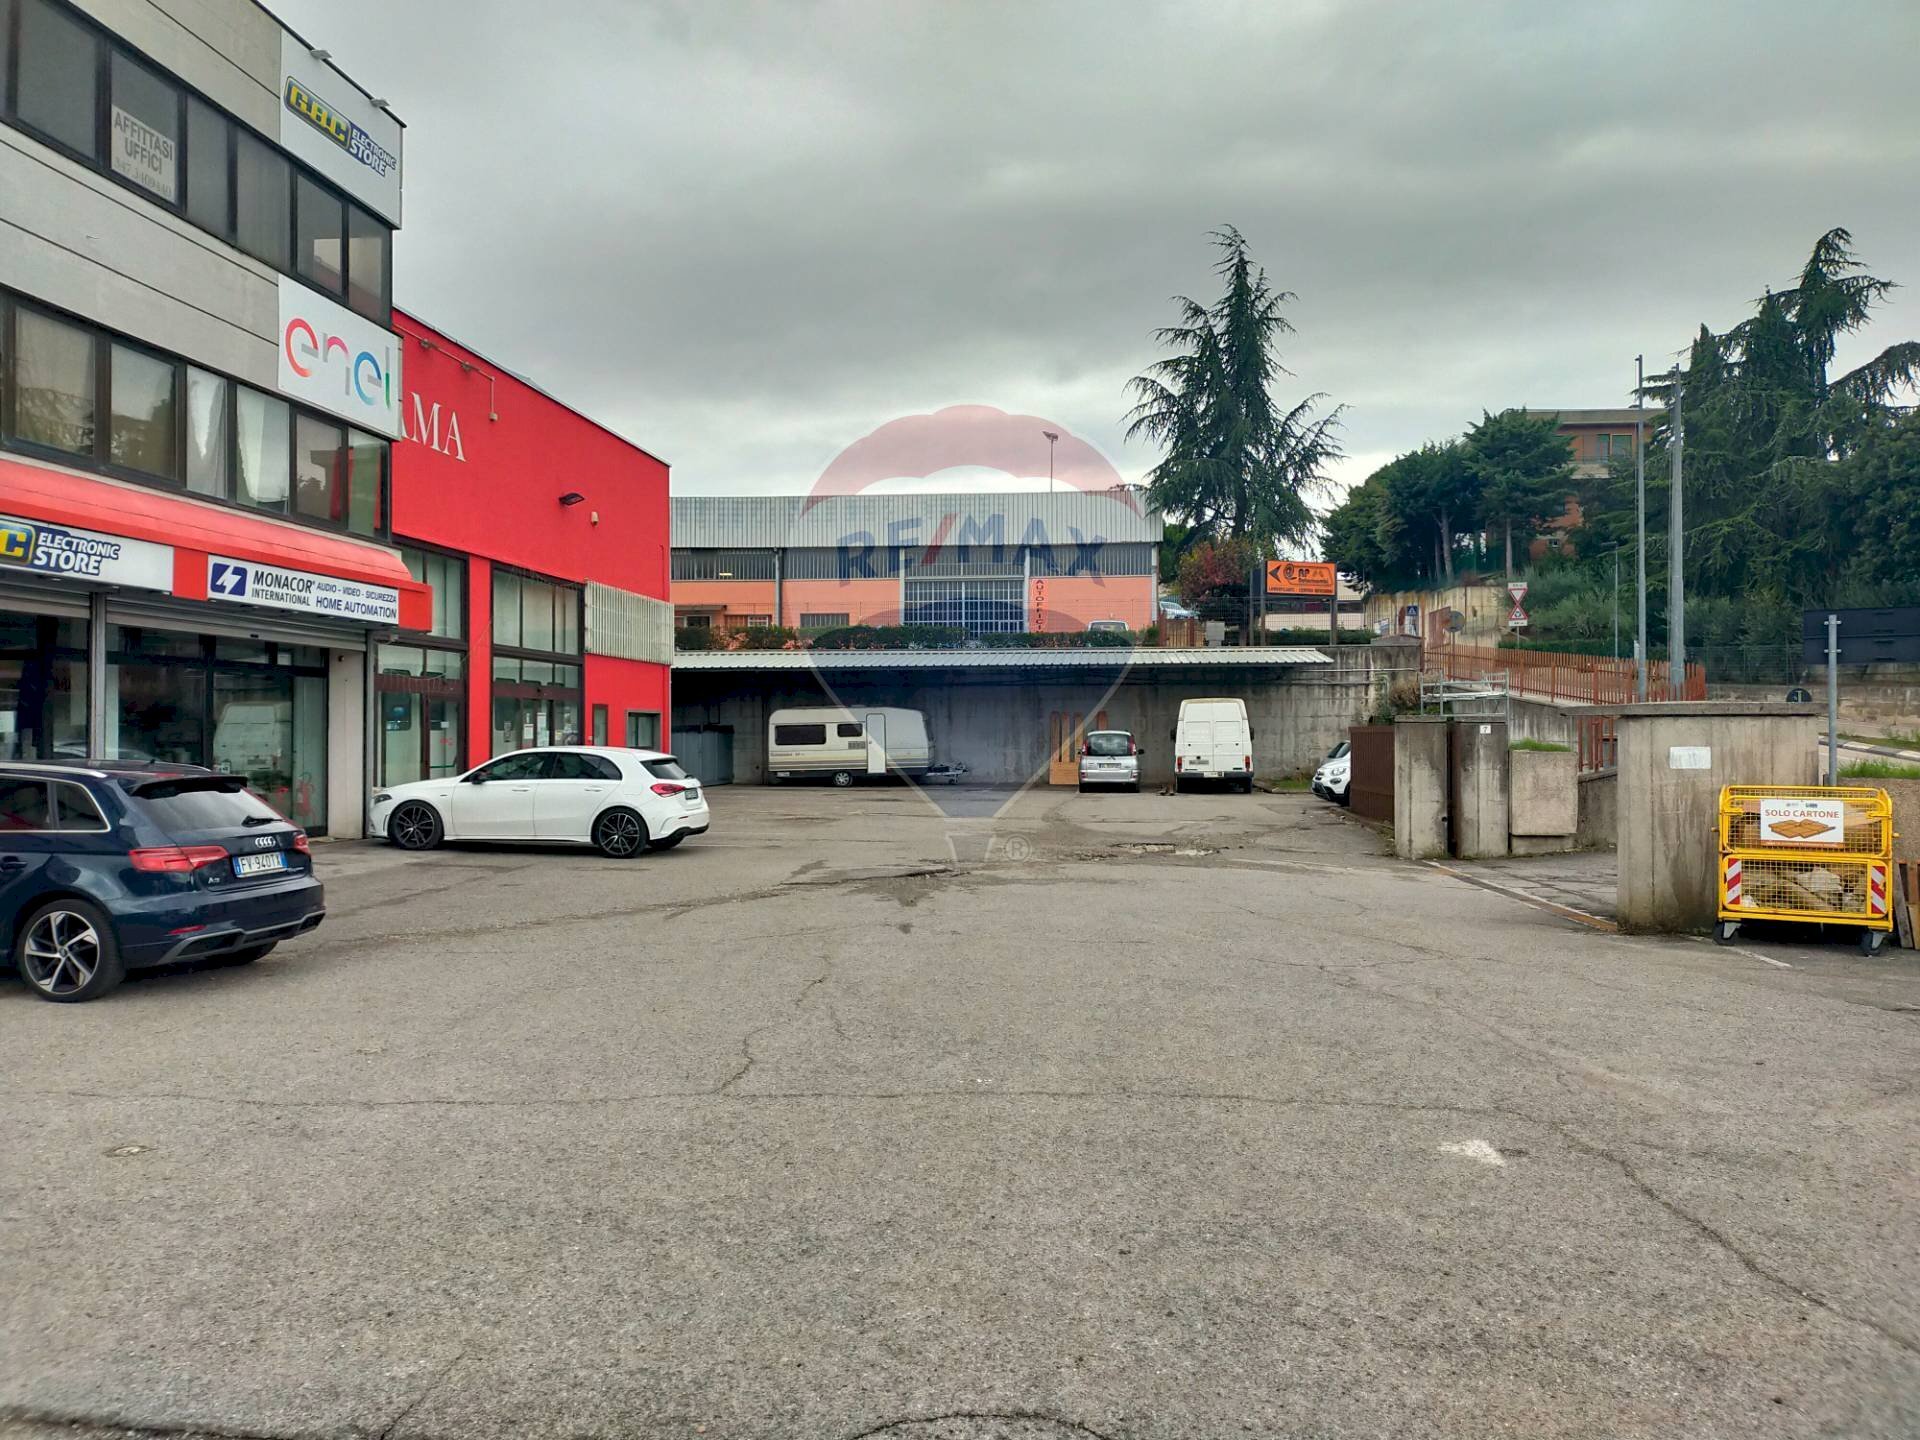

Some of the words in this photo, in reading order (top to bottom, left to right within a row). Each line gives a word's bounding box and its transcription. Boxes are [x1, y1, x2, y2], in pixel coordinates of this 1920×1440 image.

[114, 111, 173, 161] AFFITTASI
[352, 128, 397, 170] ELECTRONIC
[125, 137, 162, 175] UFFICI
[349, 139, 387, 177] STORE
[285, 318, 391, 409] enel
[401, 392, 467, 462] MA
[33, 546, 102, 574] STORE
[37, 532, 120, 559] ELECTRONIC
[252, 587, 310, 606] INTERNATIONAL
[315, 596, 342, 611] HOME
[344, 600, 397, 619] AUTOMATION
[316, 582, 337, 593] AUDIO
[342, 587, 360, 597] VIDEO
[365, 591, 397, 603] SICUREZZA
[1036, 580, 1044, 633] AUTOFFICI
[1765, 809, 1791, 817] SOLO
[1793, 809, 1839, 819] CARTONE
